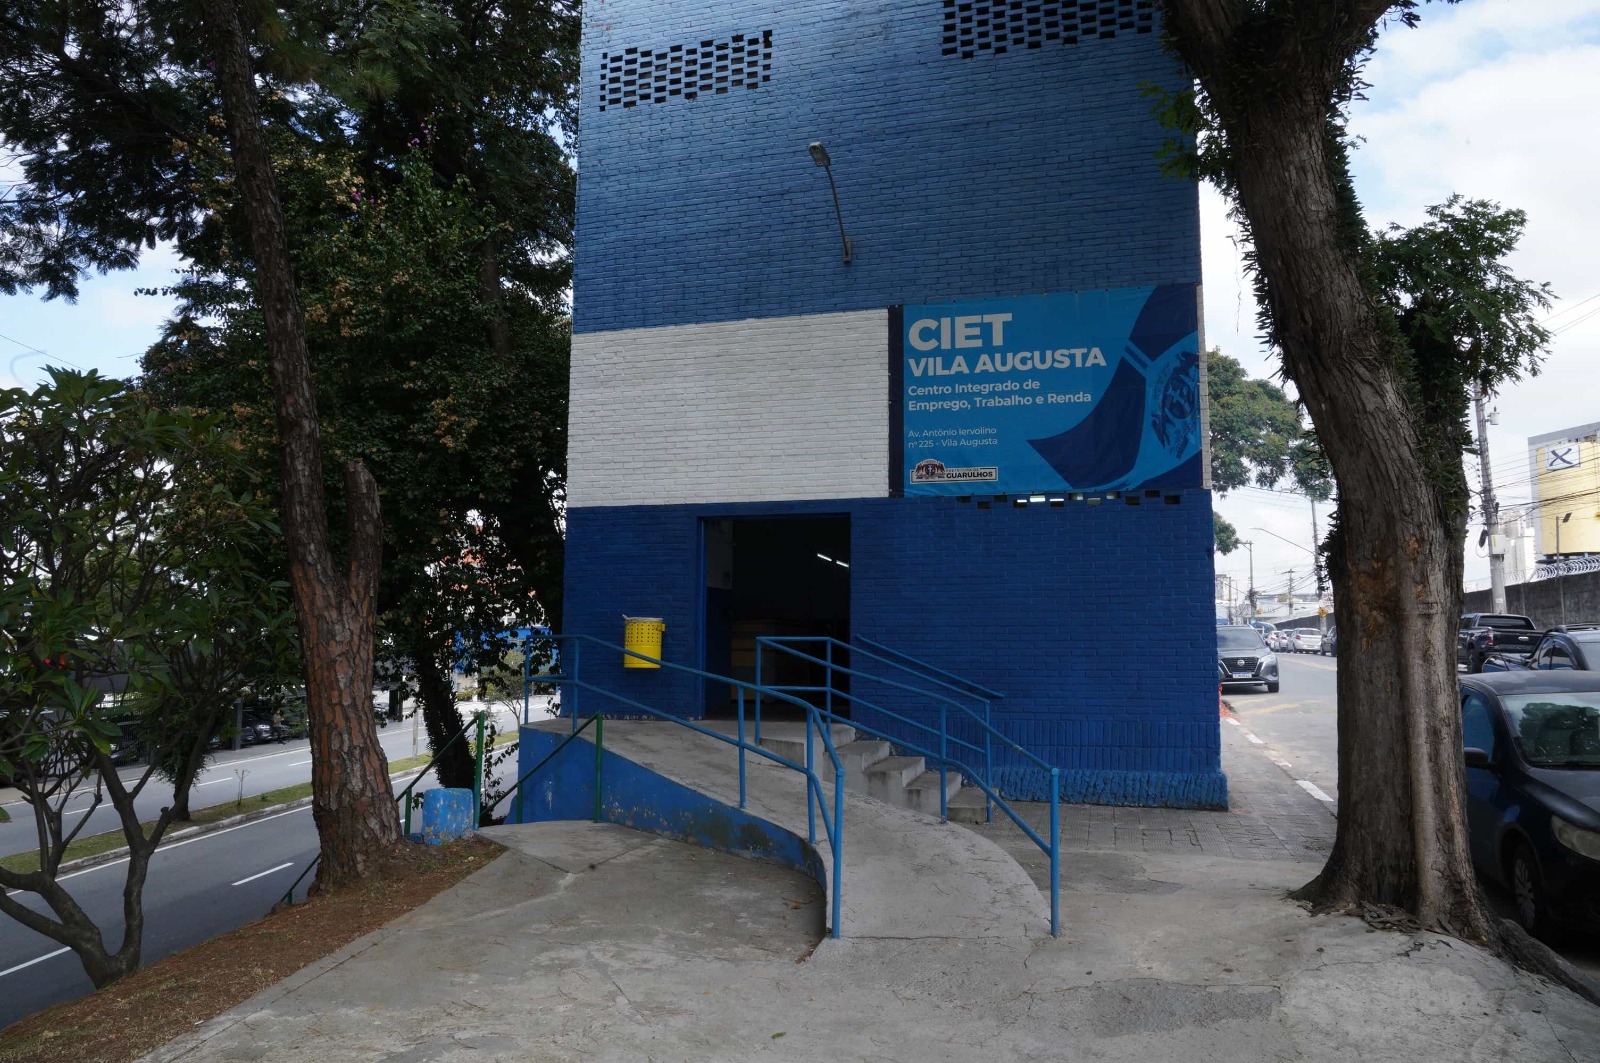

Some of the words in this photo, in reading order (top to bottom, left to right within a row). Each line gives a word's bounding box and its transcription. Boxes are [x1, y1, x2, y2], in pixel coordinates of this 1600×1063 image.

[908, 312, 1013, 351] CIET
[908, 355, 970, 377] VILA
[974, 347, 1107, 374] AUGUSTA
[908, 385, 952, 396] Centro
[955, 380, 1020, 395] Integrado
[1023, 379, 1040, 390] de
[908, 399, 971, 412] Emprego,
[974, 395, 1033, 408] Trabalho
[1036, 395, 1044, 404] e
[1047, 392, 1092, 404] Renda
[908, 430, 921, 438] Av.
[922, 428, 957, 437] Antônio
[958, 427, 997, 436] Iervolino
[918, 440, 934, 448] 225
[941, 438, 958, 447] Vila
[959, 437, 998, 447] Augusta
[946, 471, 993, 479] GUARULHOS
